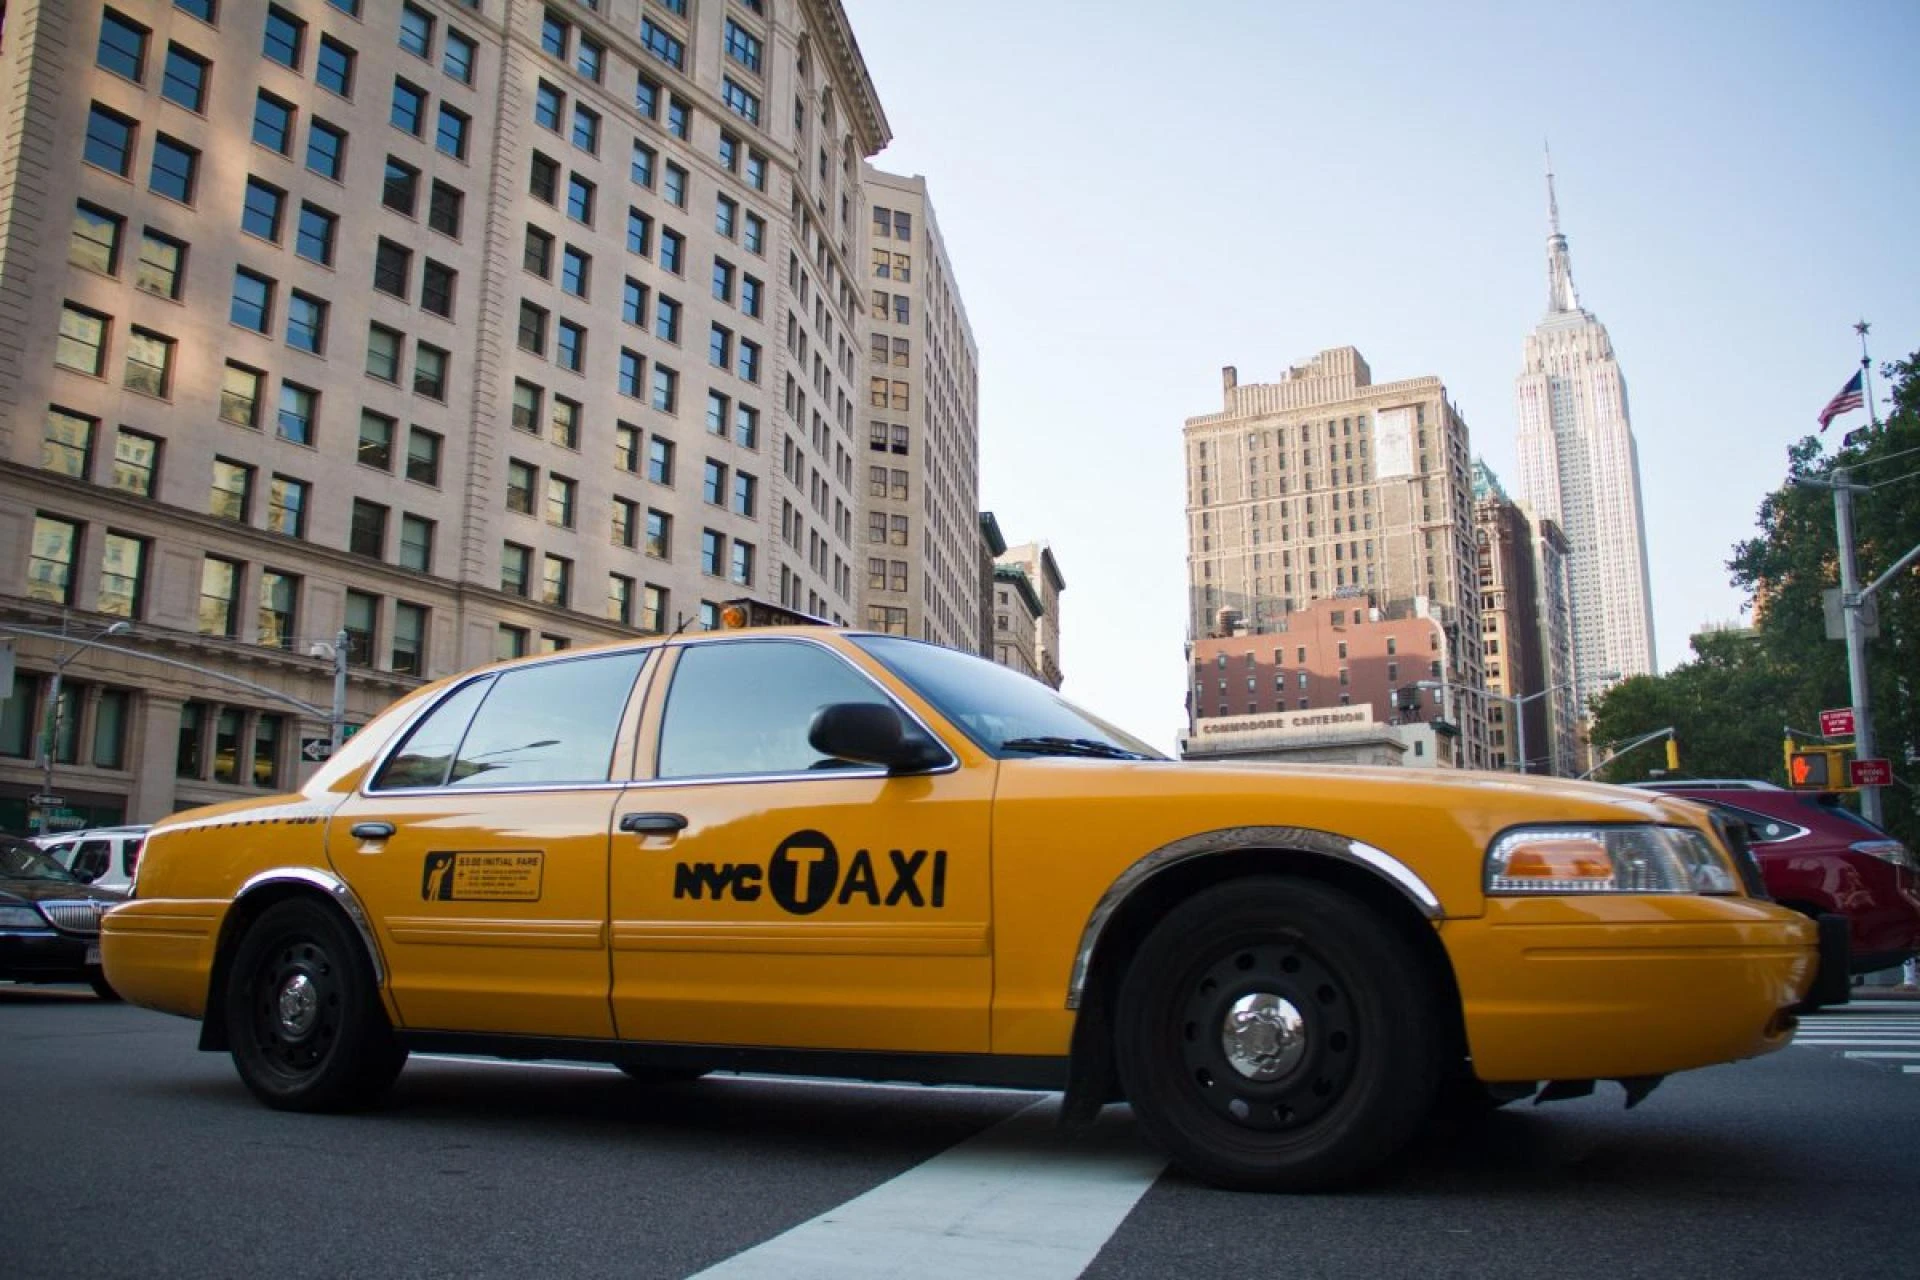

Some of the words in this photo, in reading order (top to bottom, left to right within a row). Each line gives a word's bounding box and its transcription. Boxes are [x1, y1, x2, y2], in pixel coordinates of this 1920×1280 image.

[1203, 719, 1284, 733] COMMODORE
[1292, 712, 1365, 727] CRITERION
[517, 856, 538, 865] FARE
[674, 862, 763, 901] NYC
[778, 841, 947, 910] TAXI
